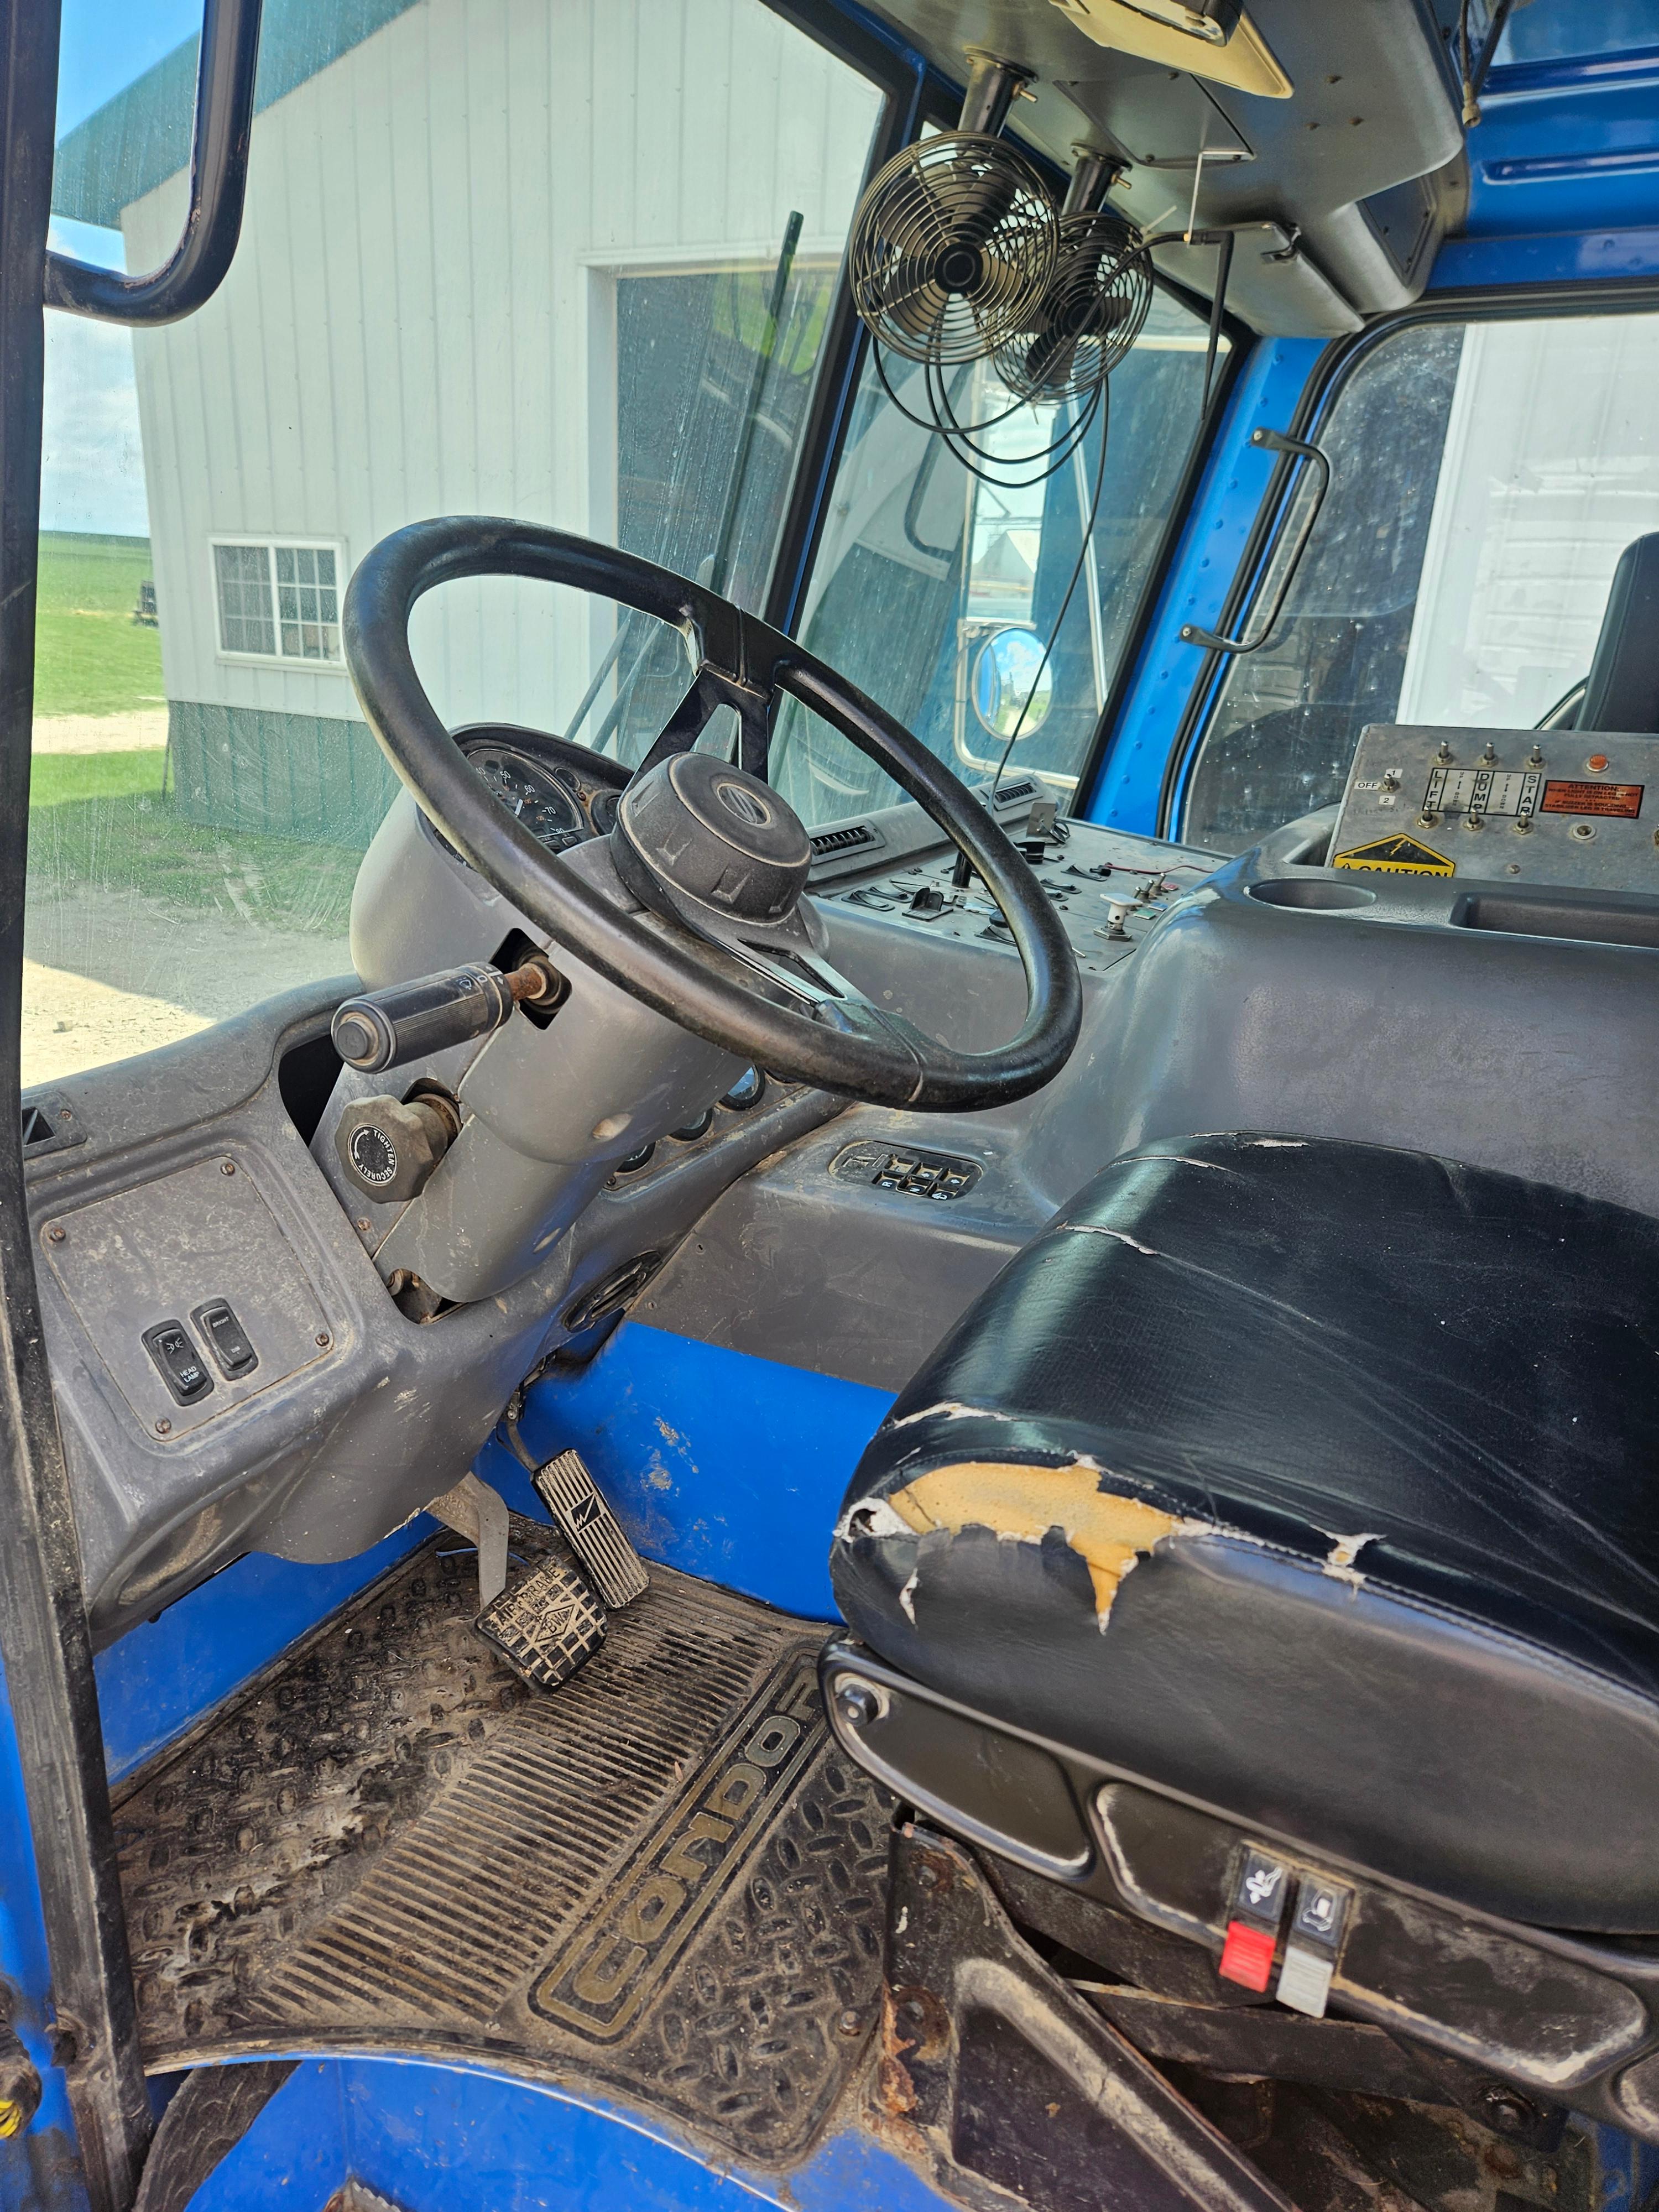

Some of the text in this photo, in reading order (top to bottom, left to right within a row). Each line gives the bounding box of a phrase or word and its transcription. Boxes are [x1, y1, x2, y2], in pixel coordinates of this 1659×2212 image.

[500, 770, 511, 779] 50
[524, 784, 535, 793] 60
[1427, 771, 1442, 810] LIFT
[1473, 773, 1490, 810] DUMP
[545, 806, 556, 815] 70
[358, 1129, 395, 1181] TIGHTEN SECURELY
[212, 1316, 229, 1328] BRIGHT
[180, 1366, 196, 1377] HEAD
[183, 1371, 200, 1383] LAMP
[573, 1666, 821, 2005] CONDOR
